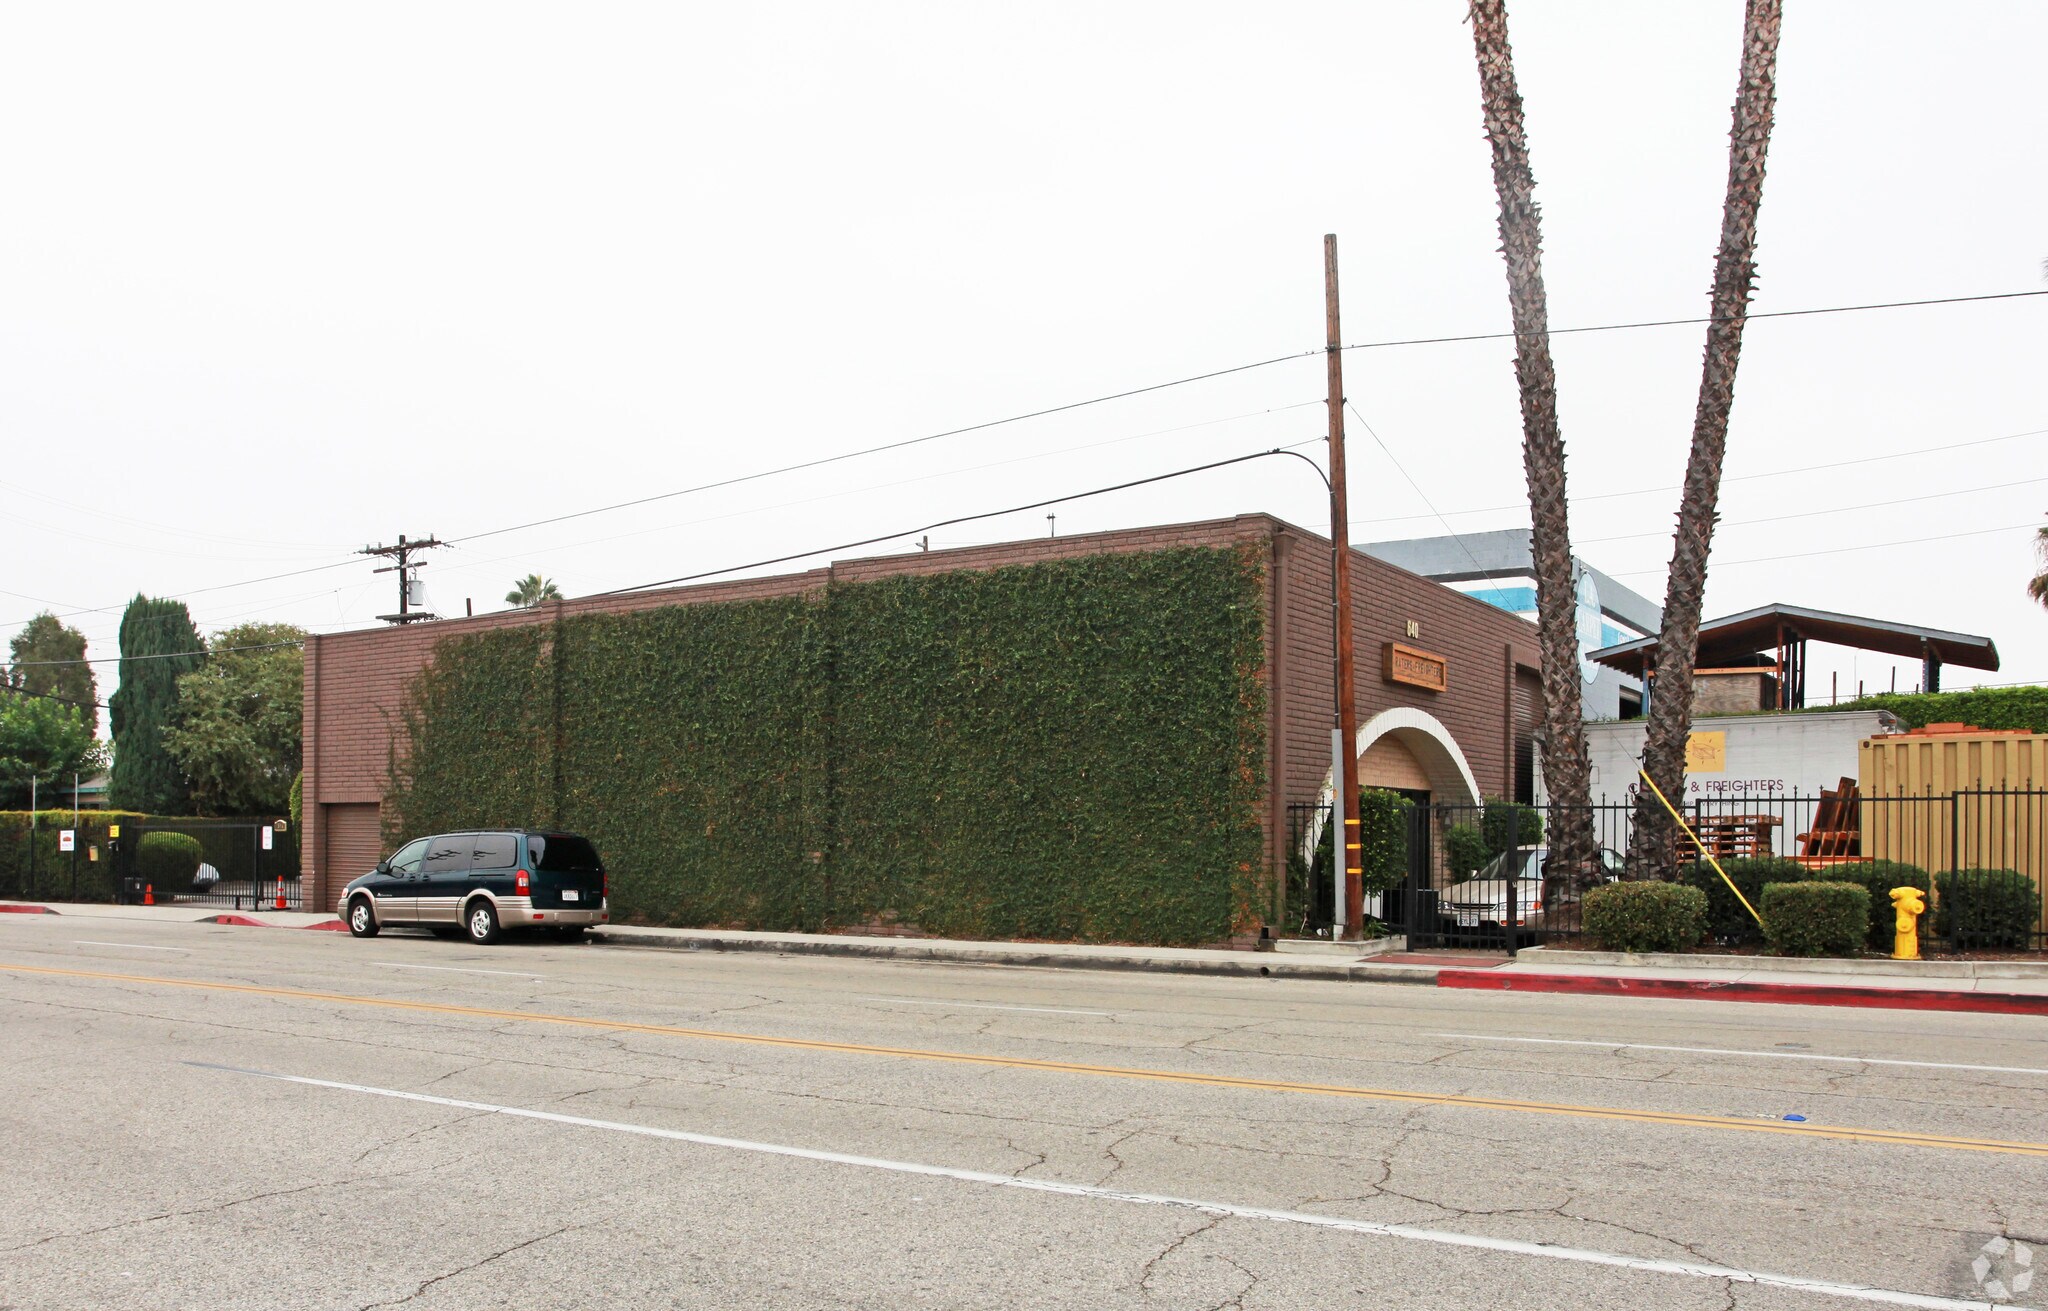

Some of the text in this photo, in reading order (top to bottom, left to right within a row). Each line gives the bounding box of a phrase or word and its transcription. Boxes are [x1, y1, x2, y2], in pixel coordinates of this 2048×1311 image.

[1407, 620, 1419, 639] 640
[1691, 780, 1783, 792] & FREIGHTERS
